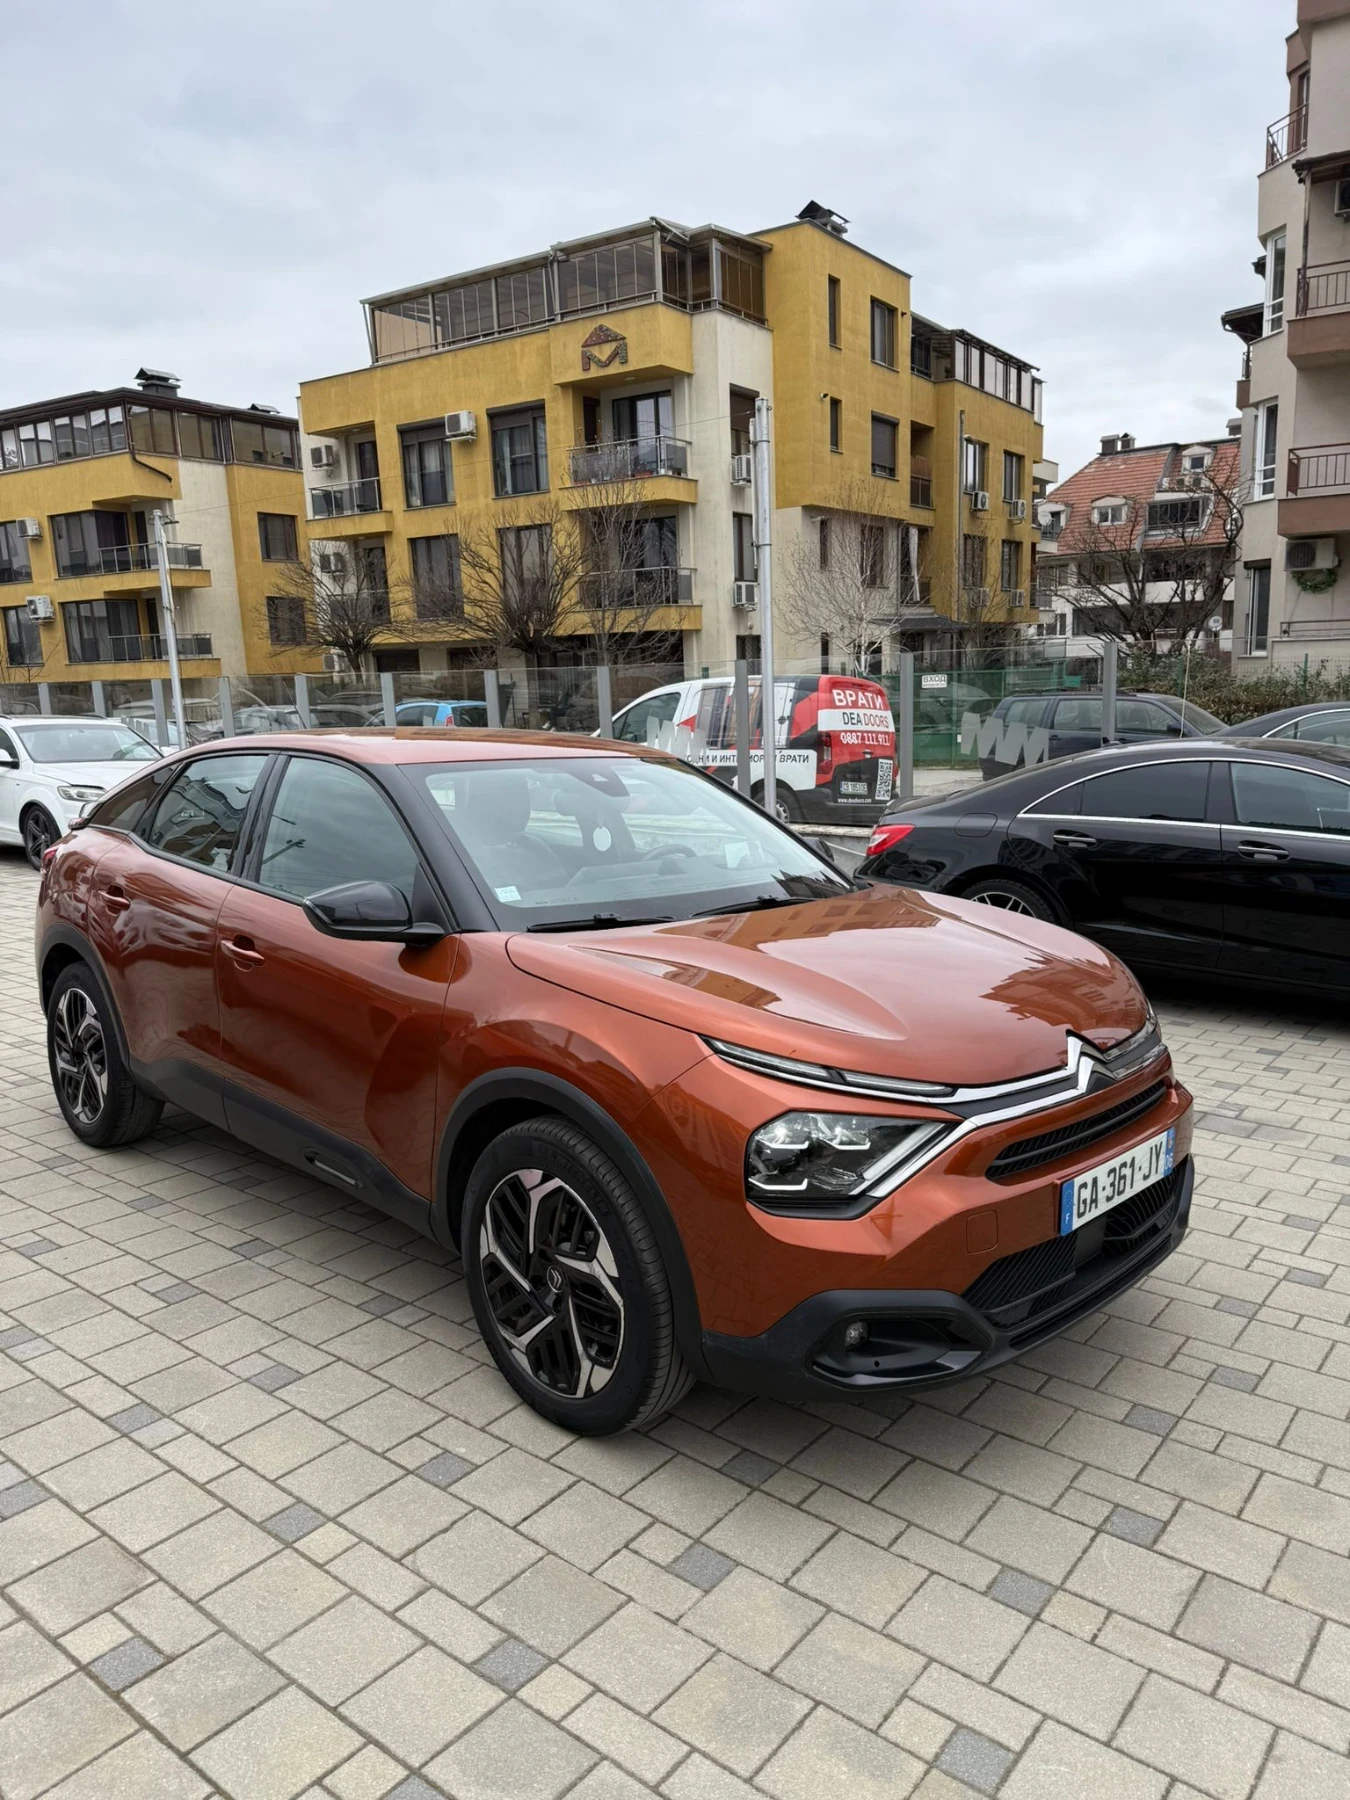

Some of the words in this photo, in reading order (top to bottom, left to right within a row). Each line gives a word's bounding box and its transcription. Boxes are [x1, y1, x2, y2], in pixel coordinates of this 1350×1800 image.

[923, 675, 946, 683] ВХОД
[832, 689, 883, 710] ВРАТИ
[842, 712, 863, 726] DEA
[863, 713, 889, 728] DOORS
[840, 732, 862, 744] 0887
[863, 733, 878, 745] 111
[878, 734, 890, 746] 911
[780, 754, 809, 763] ВРАТИ
